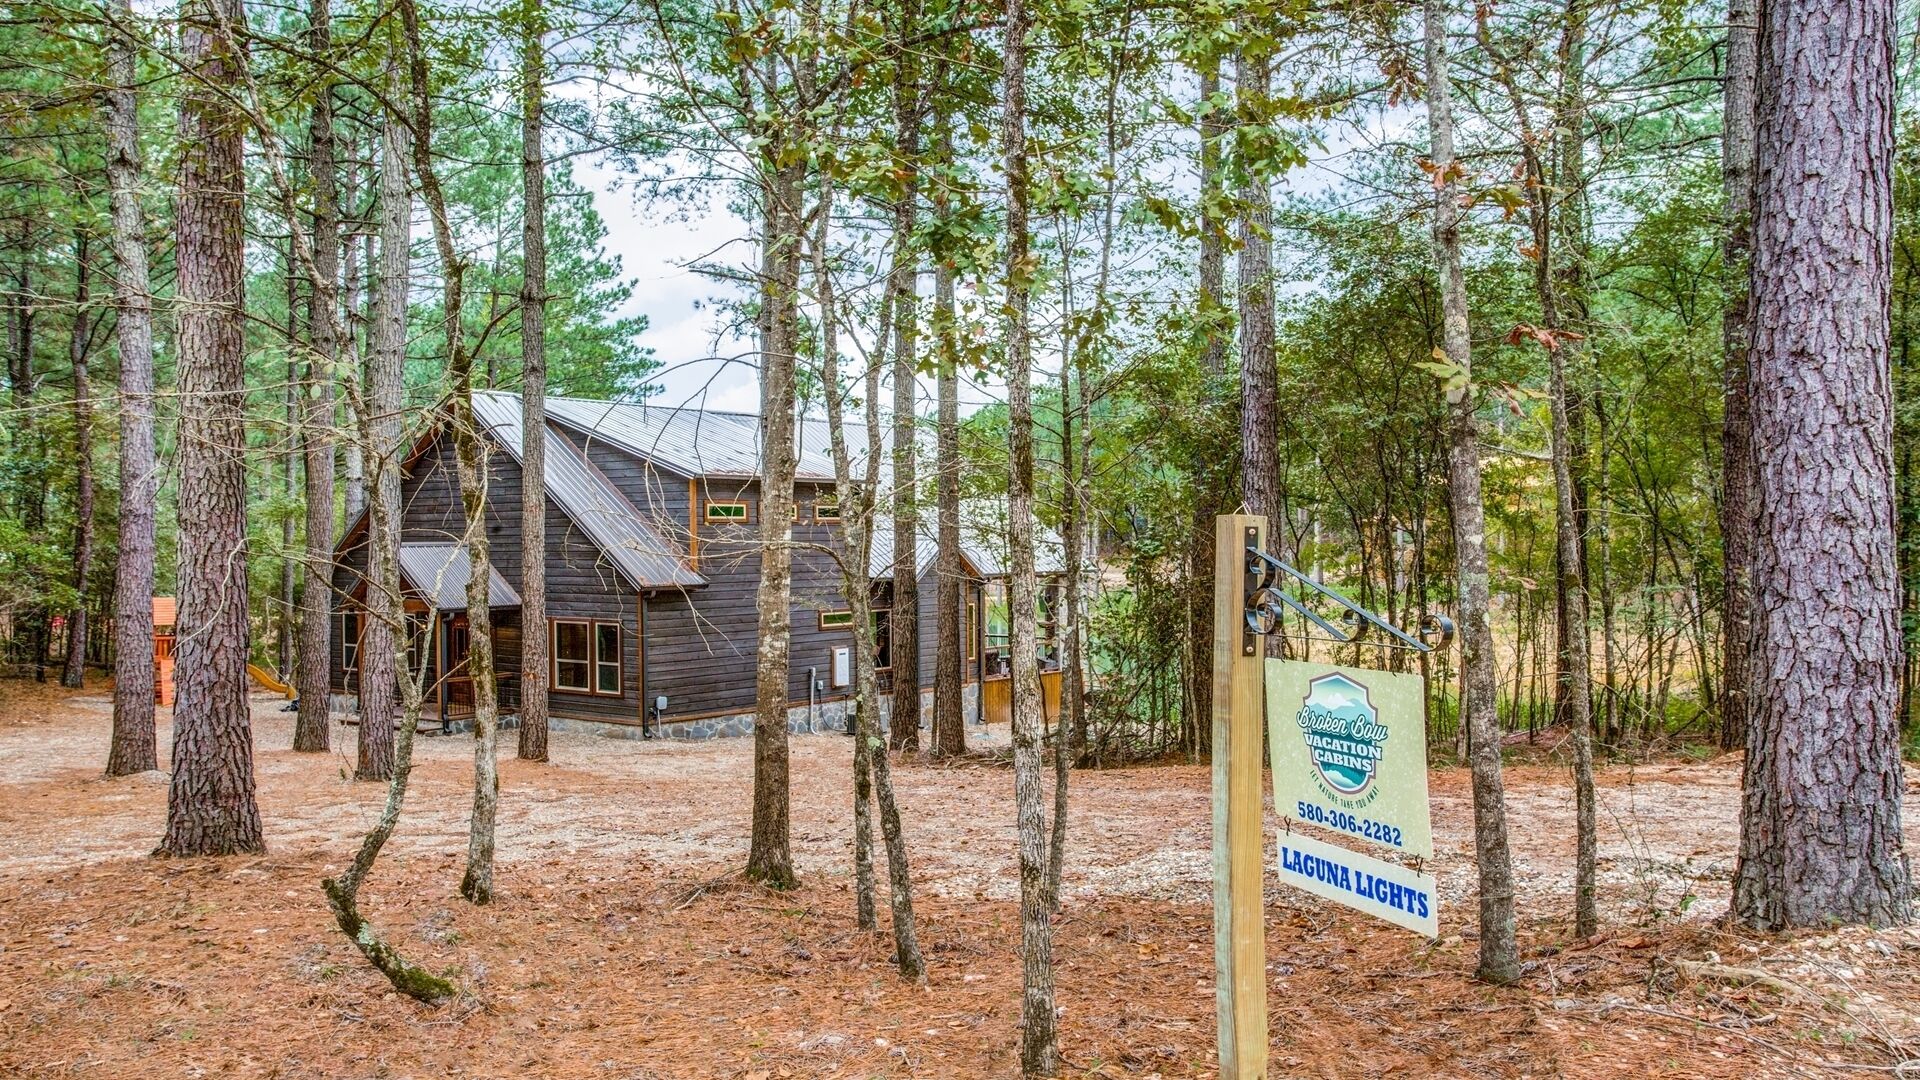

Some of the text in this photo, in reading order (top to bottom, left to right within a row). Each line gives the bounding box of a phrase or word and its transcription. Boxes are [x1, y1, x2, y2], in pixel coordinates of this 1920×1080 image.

[1297, 706, 1388, 741] Broken Bow
[1303, 732, 1382, 760] VACATION
[1314, 749, 1372, 772] CABINS
[1318, 783, 1338, 805] NATURE
[1340, 798, 1354, 810] TAKE
[1355, 798, 1367, 809] YOU
[1365, 785, 1380, 803] AWAY
[1298, 801, 1403, 847] 580-306-2282
[1281, 846, 1429, 919] LAGUNA LIGHTS
